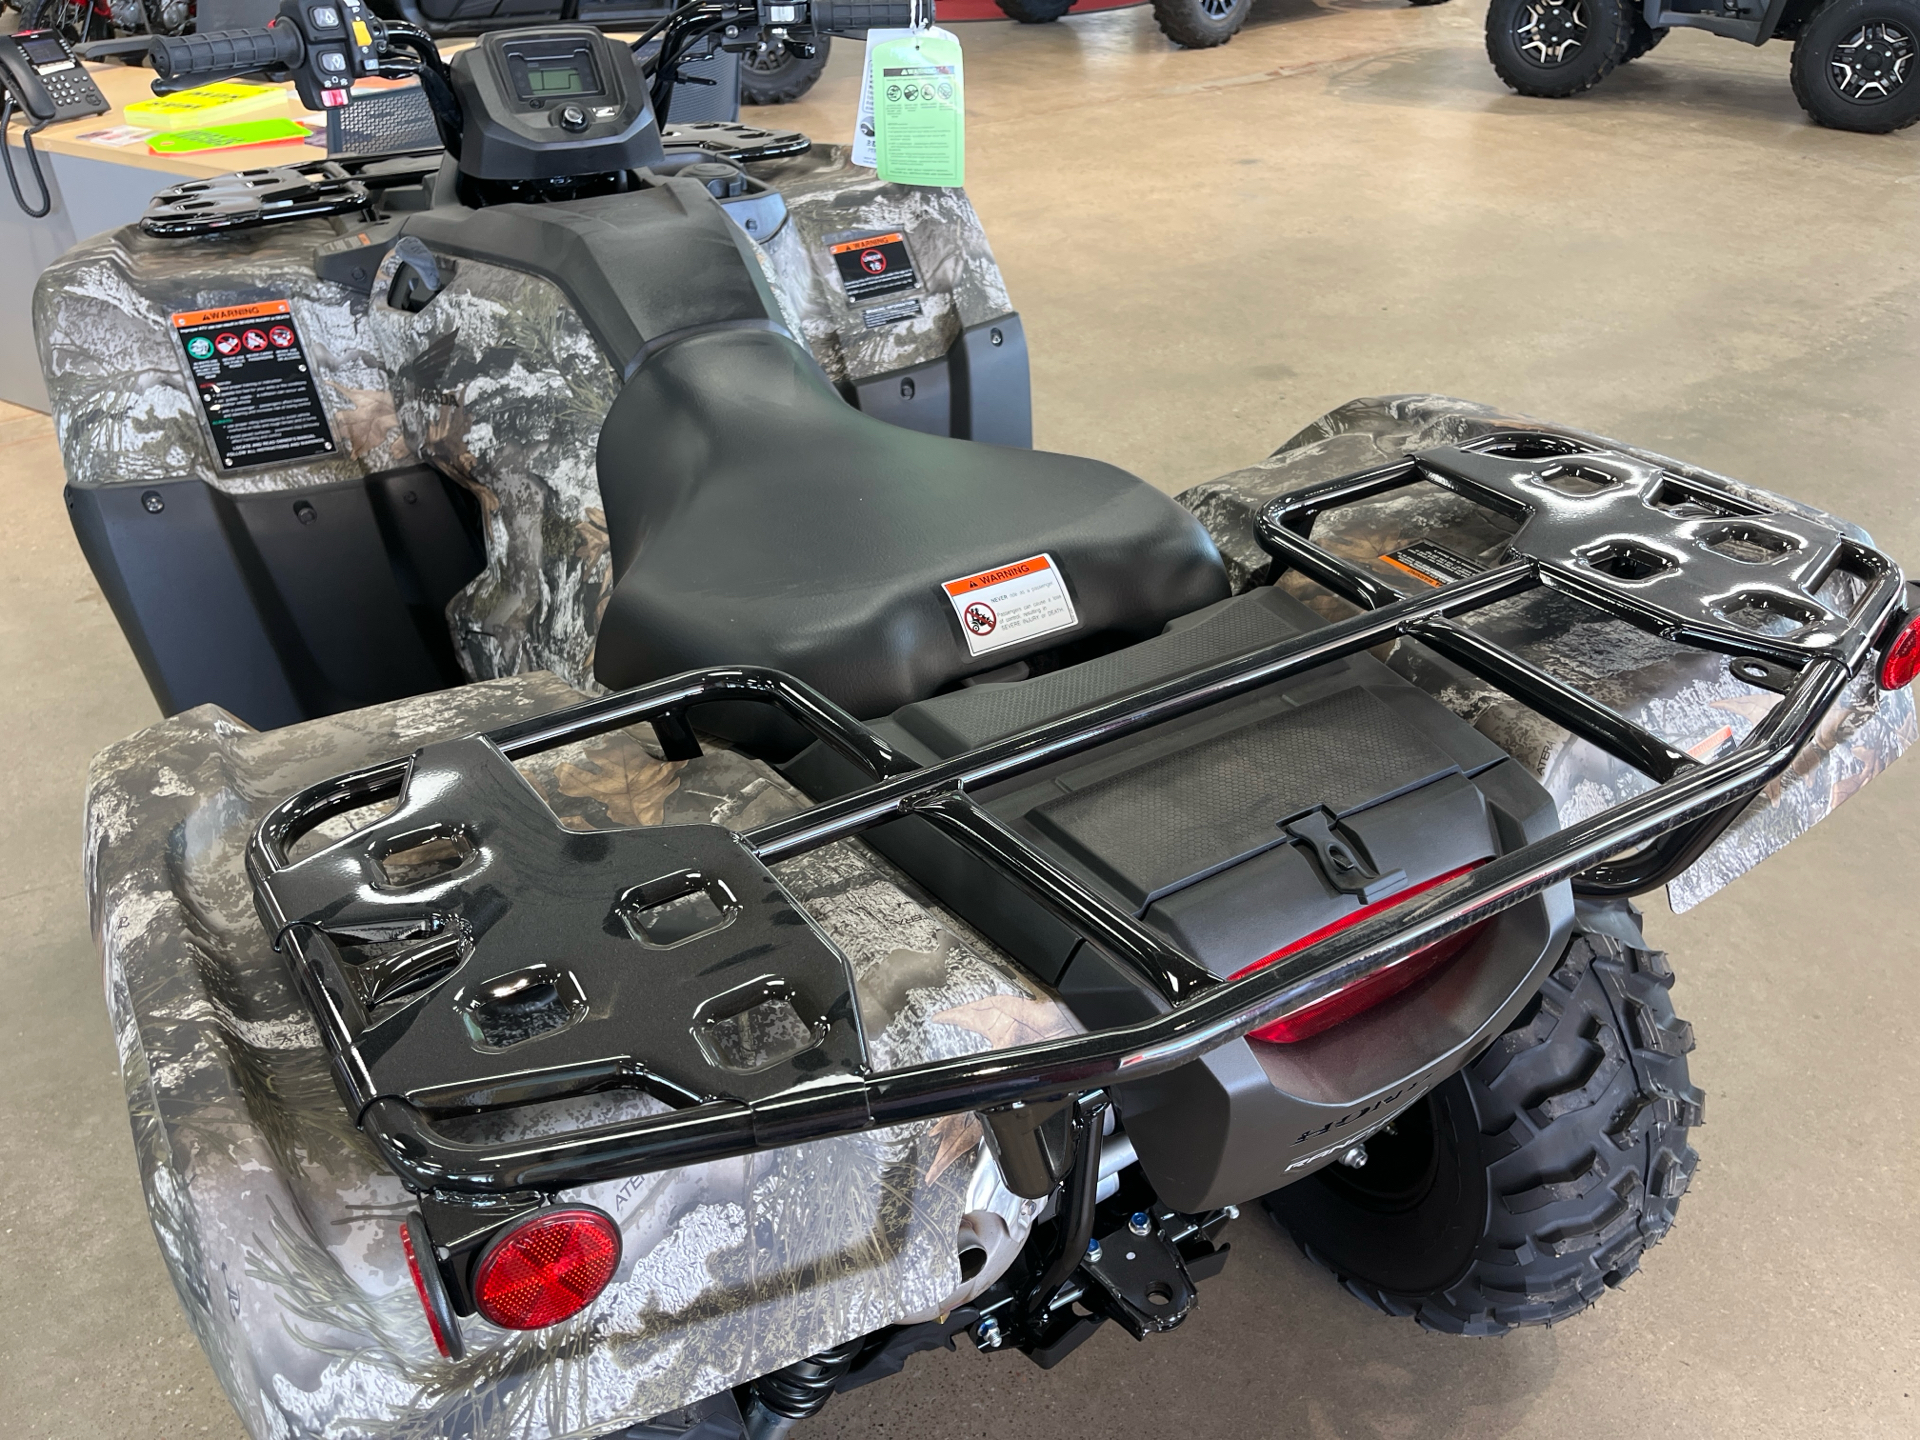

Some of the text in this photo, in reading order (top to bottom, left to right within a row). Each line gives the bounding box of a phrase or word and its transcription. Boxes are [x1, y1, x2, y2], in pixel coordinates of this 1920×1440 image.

[854, 237, 889, 248] WARNING
[870, 262, 882, 270] 16
[210, 306, 260, 320] WARNING
[980, 564, 1030, 584] WARNING
[990, 594, 1008, 603] NEVER
[1001, 620, 1022, 630] SEVERE
[1023, 615, 1039, 624] INJURY
[1536, 740, 1556, 776] ATERA
